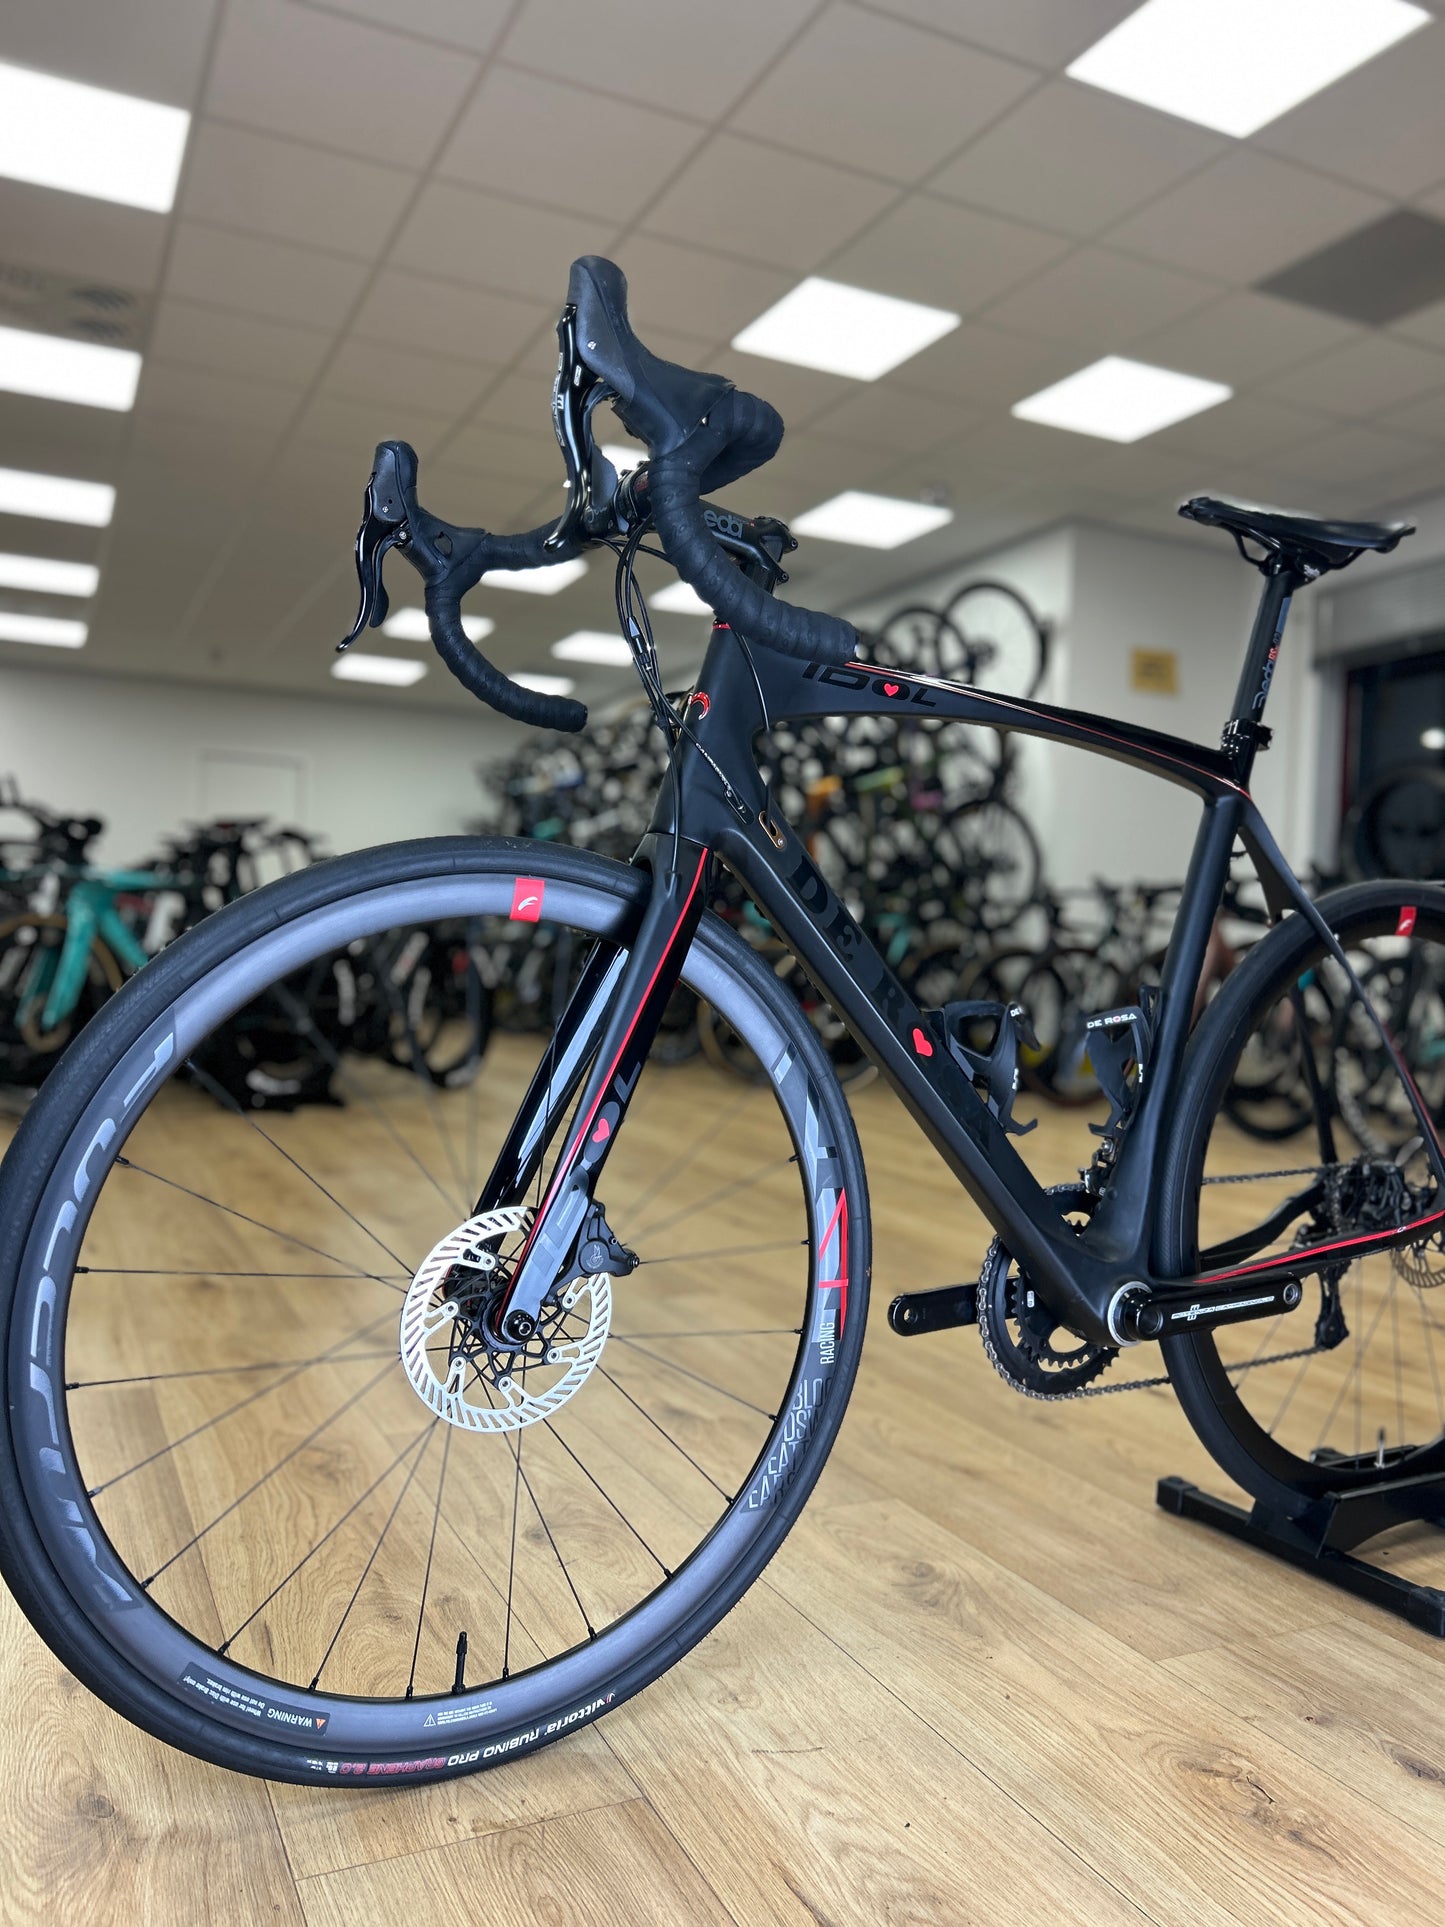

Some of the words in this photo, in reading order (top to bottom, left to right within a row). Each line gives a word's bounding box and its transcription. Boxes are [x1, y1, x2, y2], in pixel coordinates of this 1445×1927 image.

[704, 509, 743, 538] eda
[1086, 1019, 1103, 1029] DE
[1104, 1013, 1137, 1025] ROSA
[819, 1321, 835, 1365] RACING
[267, 1708, 312, 1727] WARNING
[483, 1728, 539, 1759] RUBINO
[447, 1750, 480, 1767] PRO
